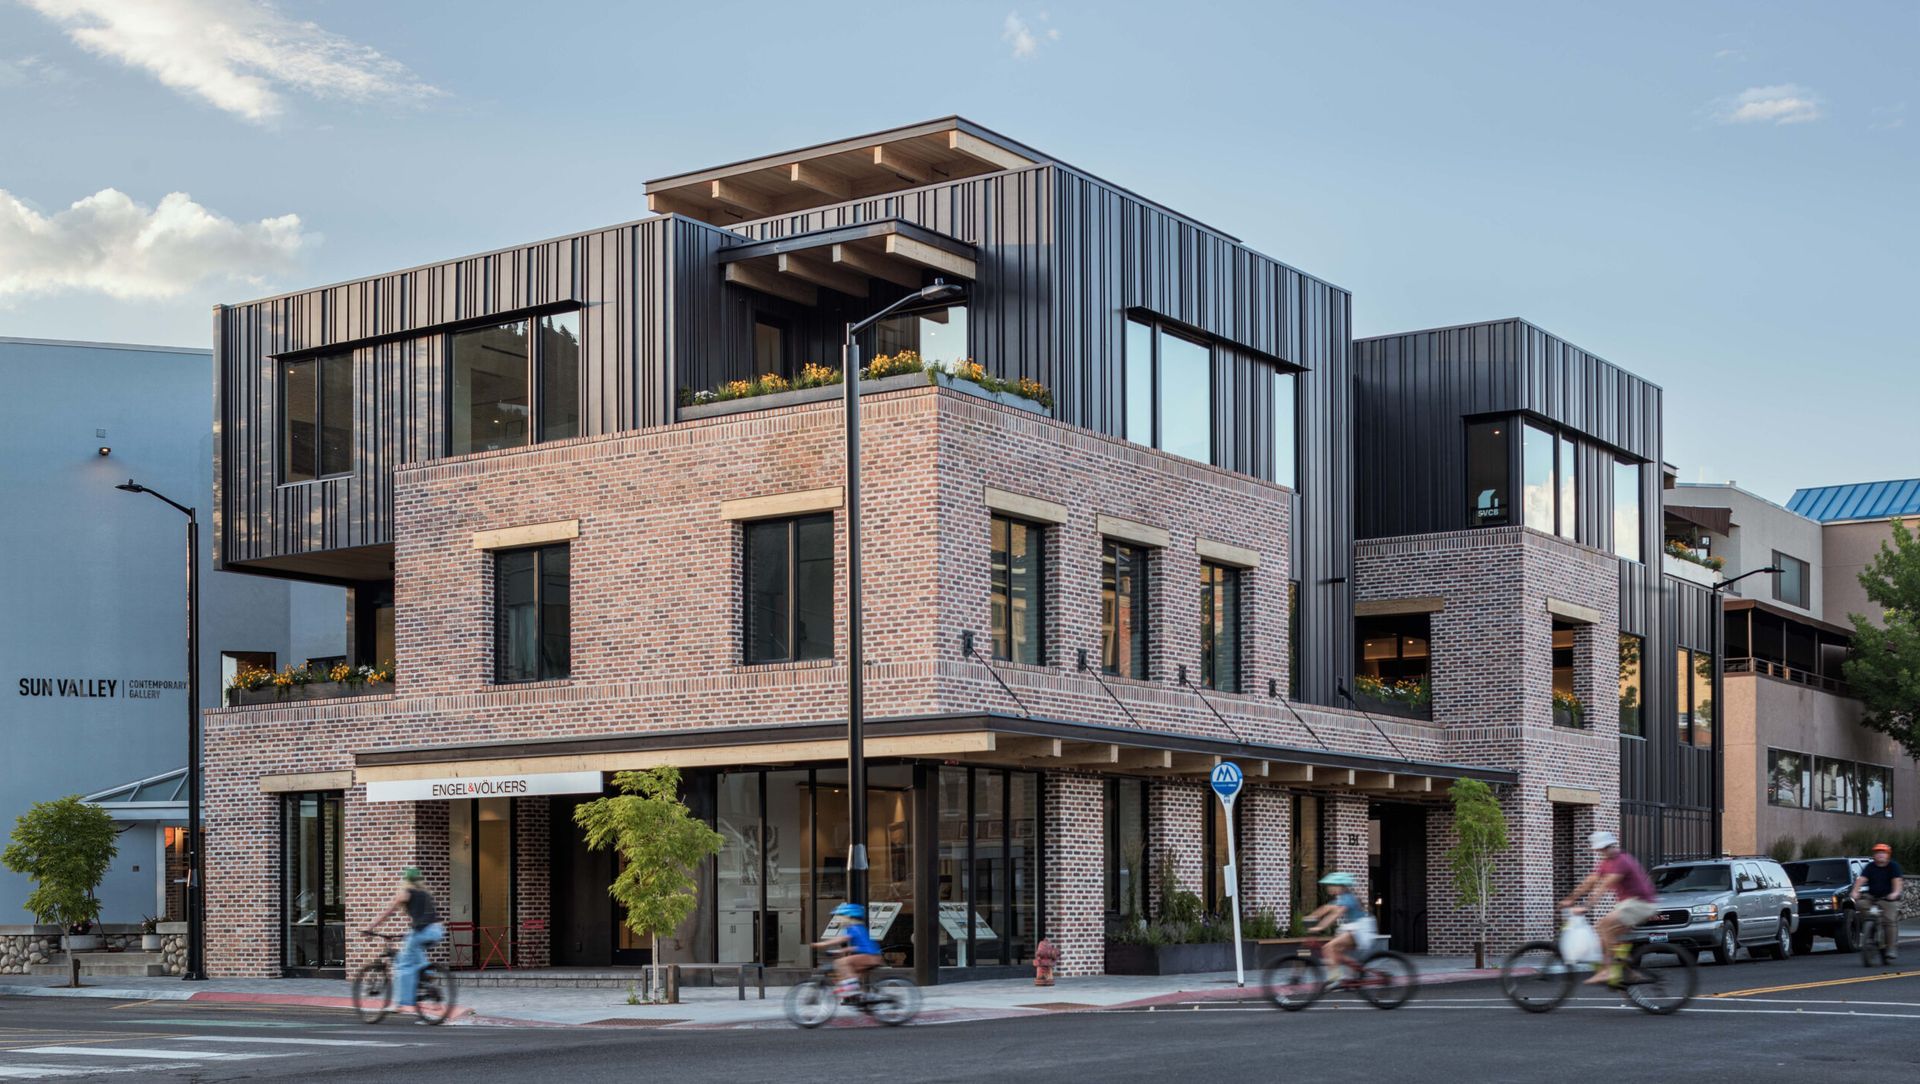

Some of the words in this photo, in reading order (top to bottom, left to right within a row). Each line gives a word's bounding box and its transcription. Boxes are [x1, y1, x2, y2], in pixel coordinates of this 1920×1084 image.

[1478, 509, 1499, 517] SVCB
[19, 678, 53, 697] SUN
[57, 679, 117, 698] VALLEY
[129, 680, 187, 690] CONTEMPORARY
[129, 690, 161, 699] GALLERY
[432, 779, 527, 796] ENGEL&VÖLKERS
